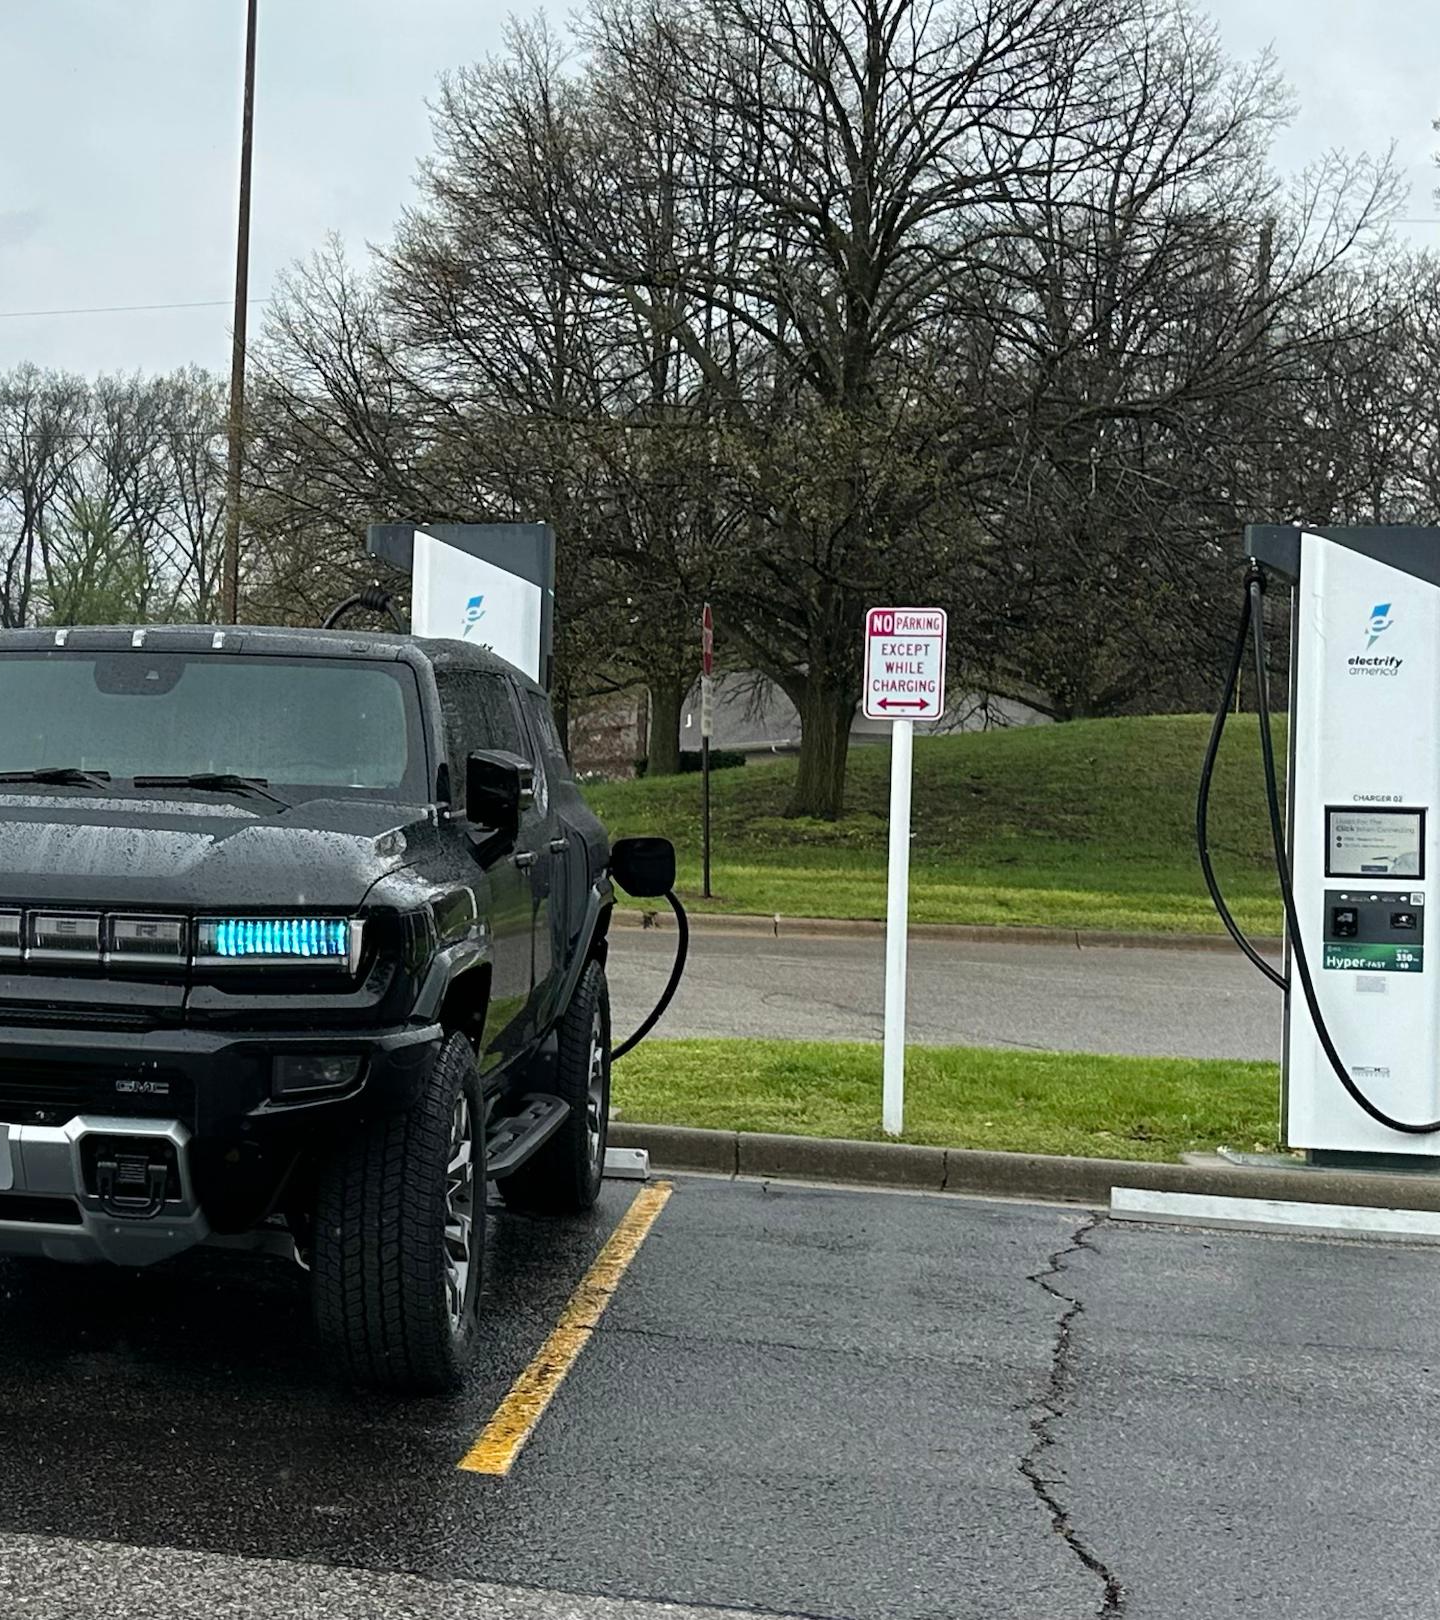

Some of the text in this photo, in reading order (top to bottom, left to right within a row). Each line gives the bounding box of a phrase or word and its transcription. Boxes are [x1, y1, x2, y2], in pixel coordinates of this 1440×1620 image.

[873, 615, 940, 632] NO PARKING
[881, 643, 930, 656] EXCEPT
[885, 661, 924, 674] WHILE
[1348, 656, 1403, 668] electrify
[1349, 667, 1398, 676] america
[872, 679, 936, 692] CHARGING
[1353, 794, 1392, 802] CHARGER
[116, 1080, 169, 1094] GMC
